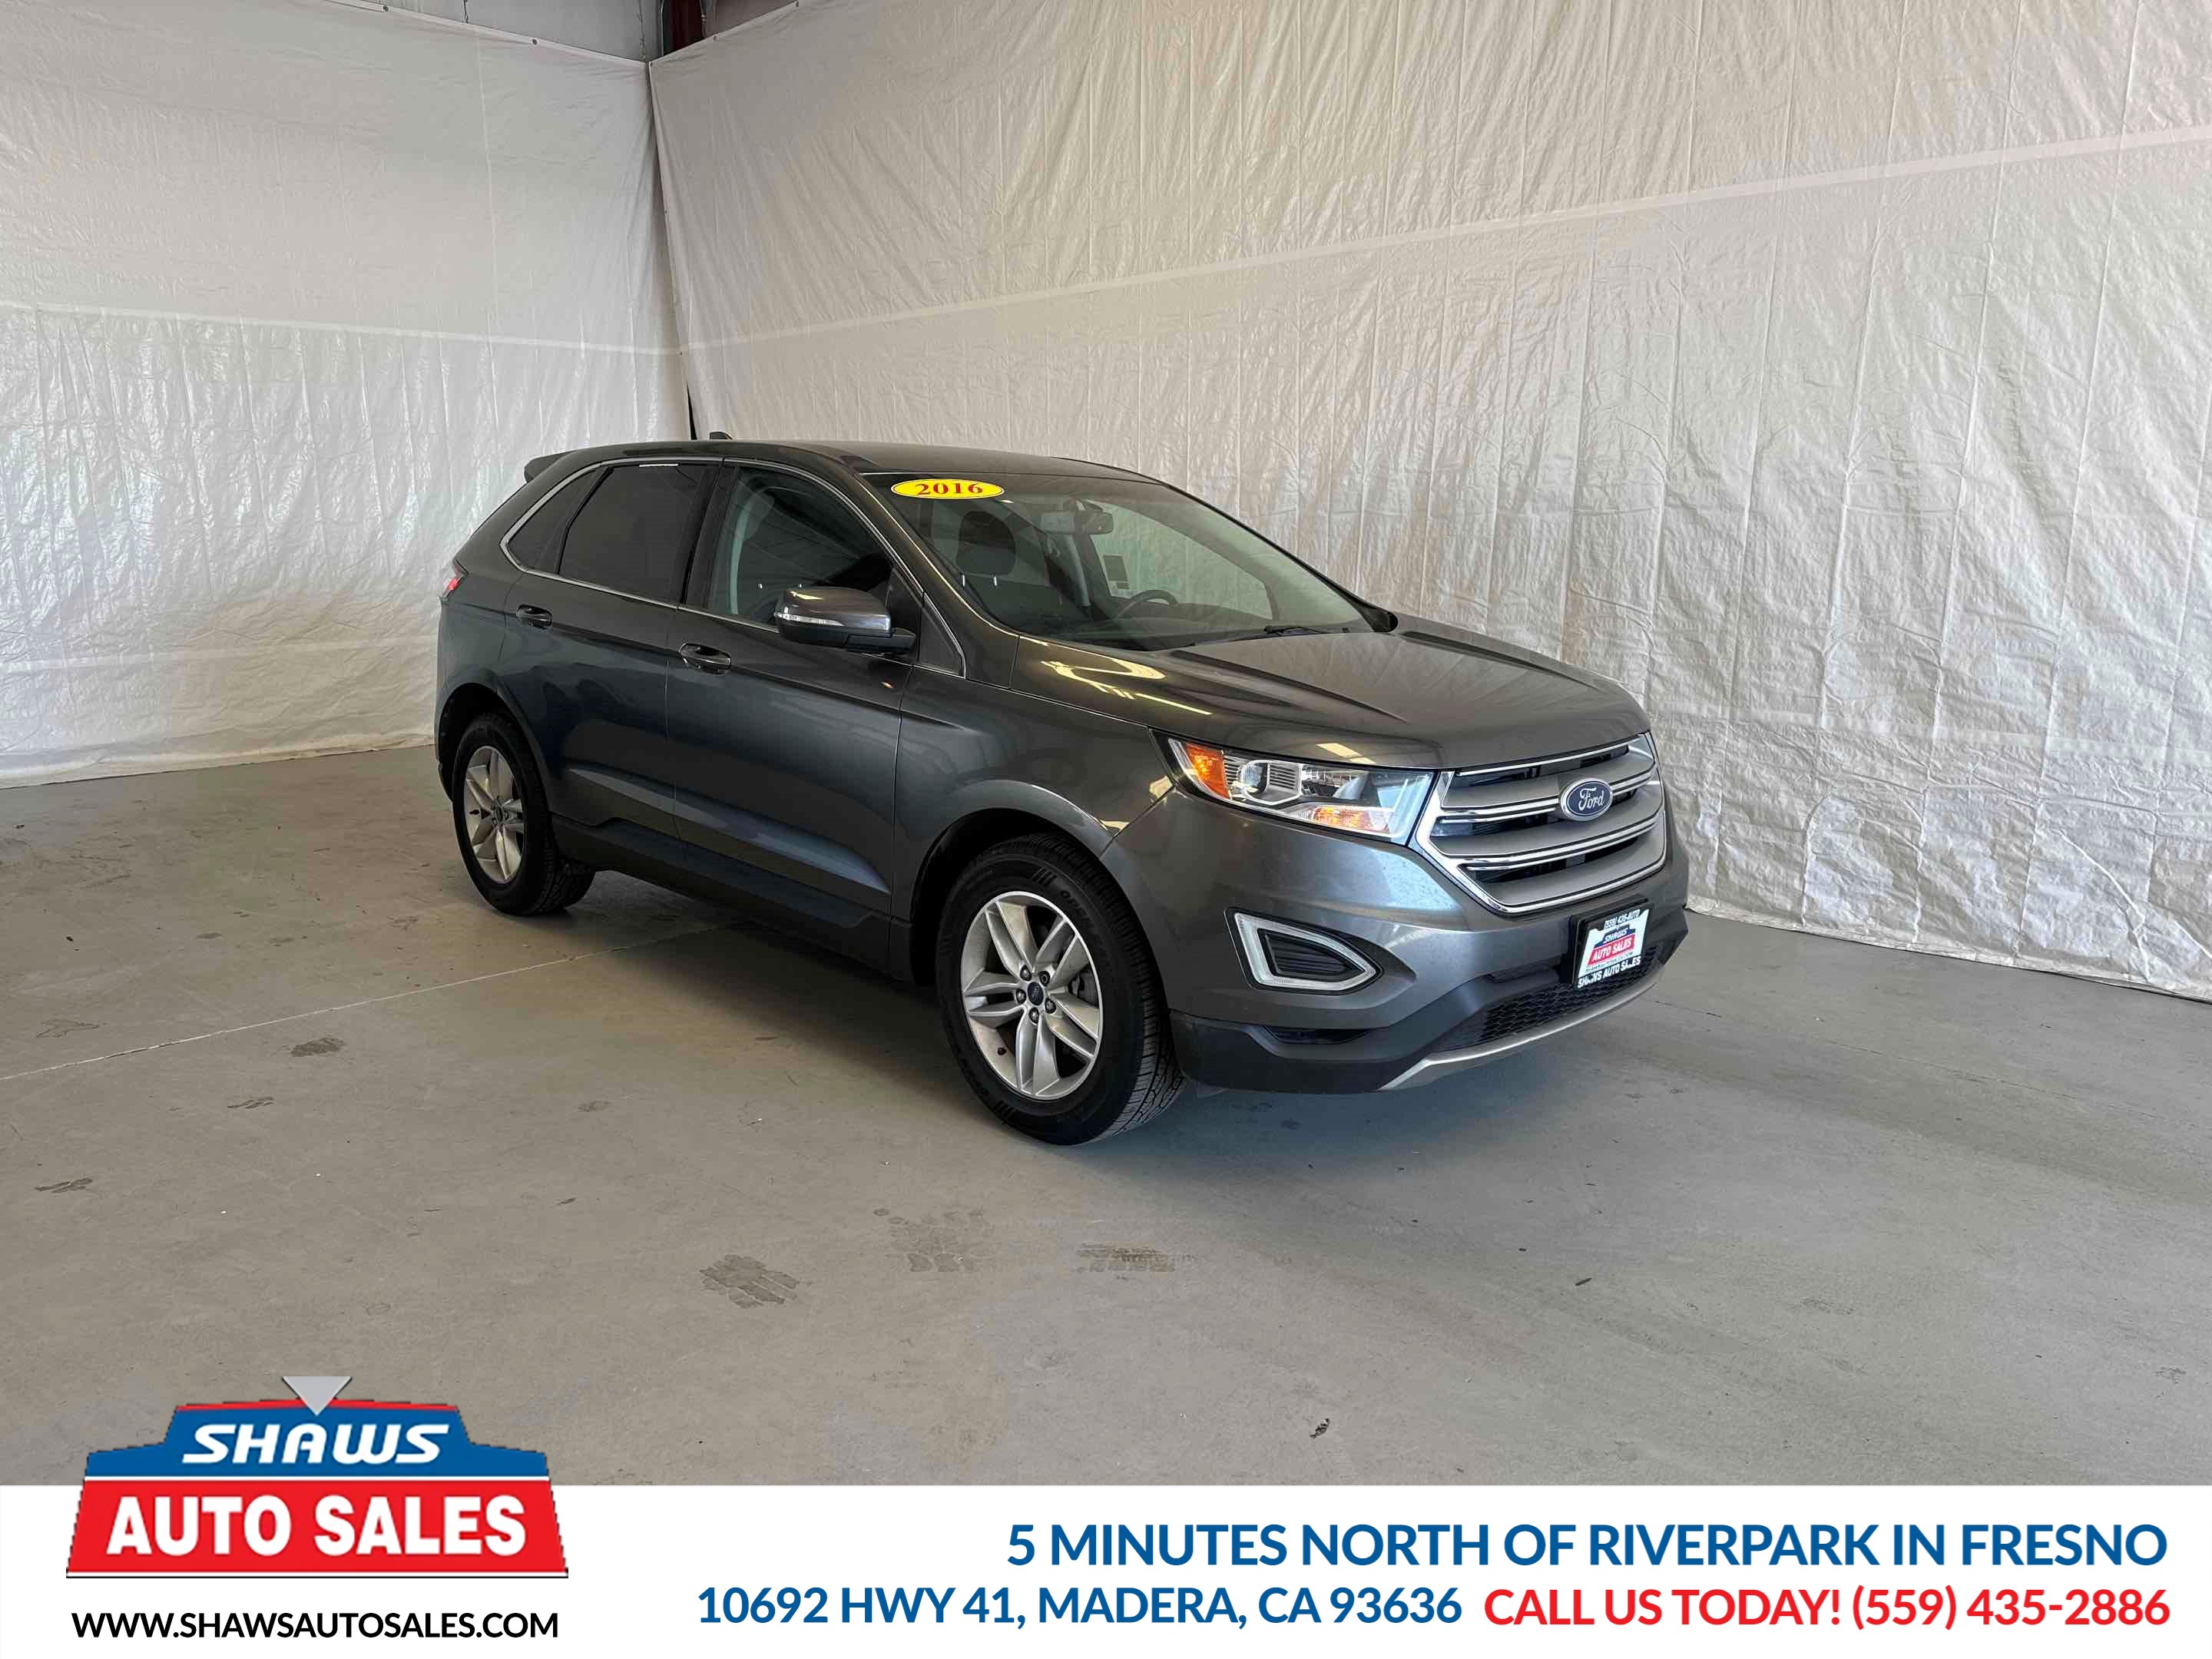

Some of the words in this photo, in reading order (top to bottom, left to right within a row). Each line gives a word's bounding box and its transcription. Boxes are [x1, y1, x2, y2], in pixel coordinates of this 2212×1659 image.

[915, 482, 983, 495] 2016
[1578, 787, 1604, 811] Ford
[1603, 928, 1629, 943] SHAWS
[1591, 945, 1611, 962] AUTO
[1611, 937, 1633, 954] SALES
[1603, 963, 1621, 979] AUTO
